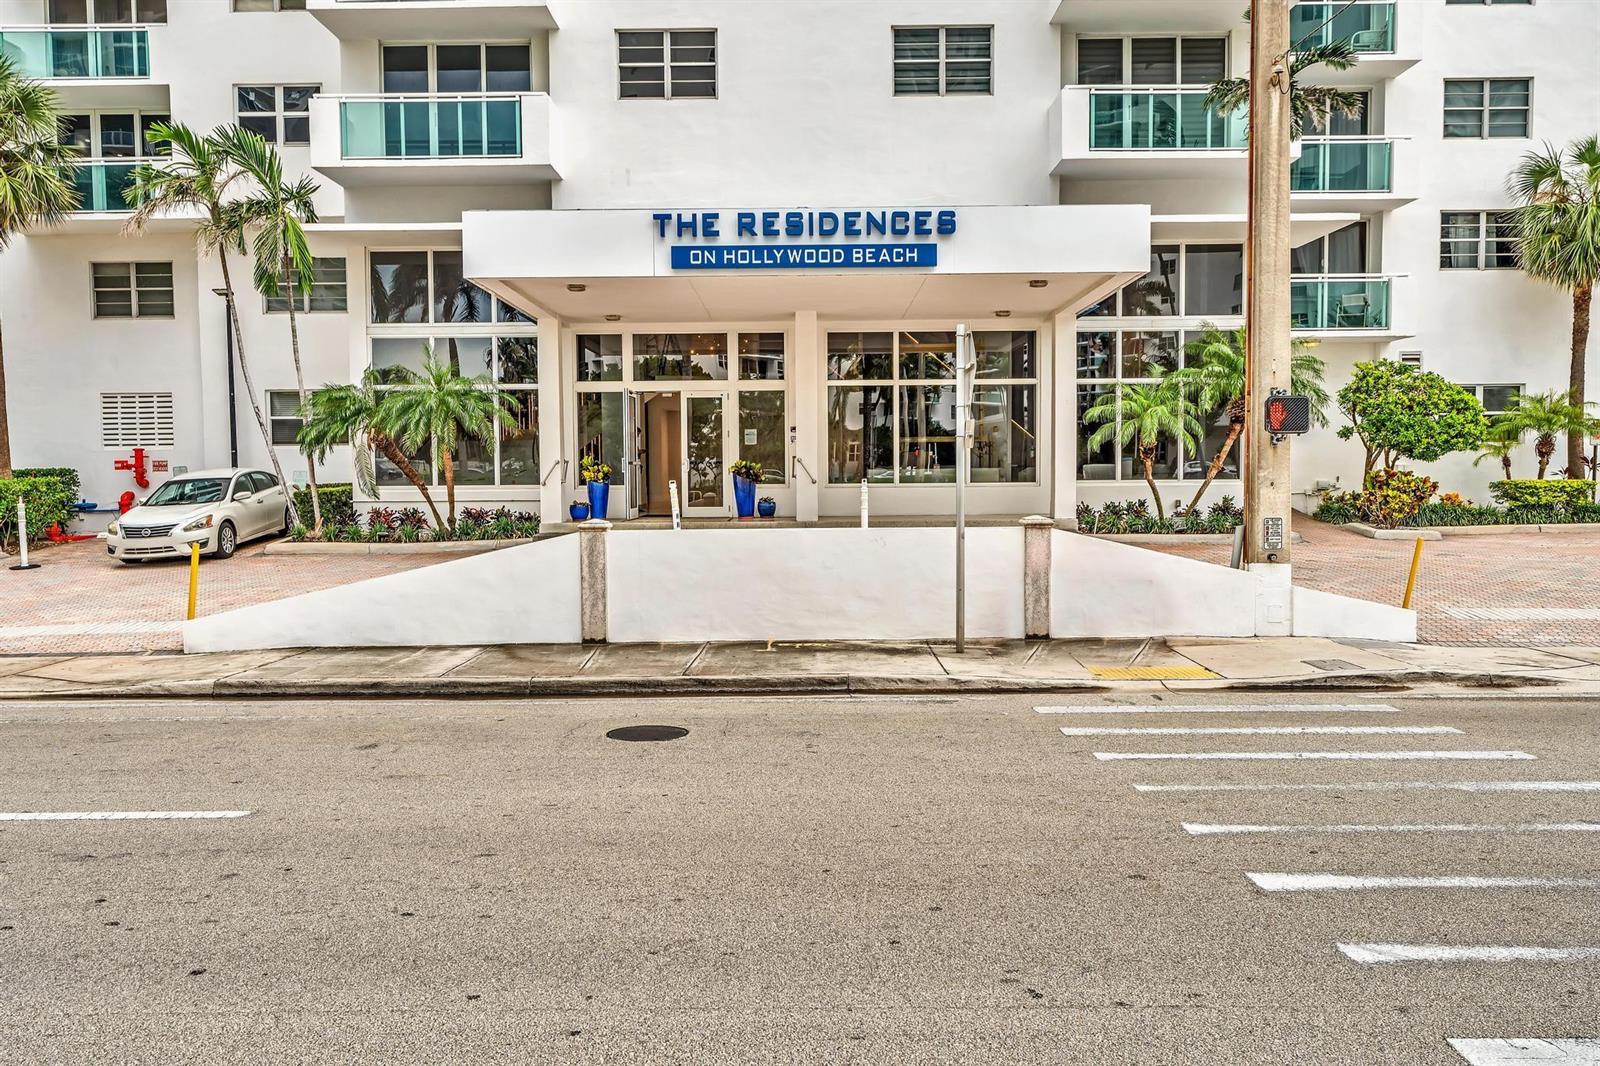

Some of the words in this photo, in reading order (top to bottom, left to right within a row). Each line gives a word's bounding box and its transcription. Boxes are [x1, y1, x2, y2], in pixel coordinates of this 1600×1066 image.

[653, 213, 719, 237] THE
[738, 211, 956, 236] RESIDENCES
[690, 250, 716, 264] ON
[723, 249, 845, 264] HOLLYWOOD
[852, 248, 918, 263] BEACH
